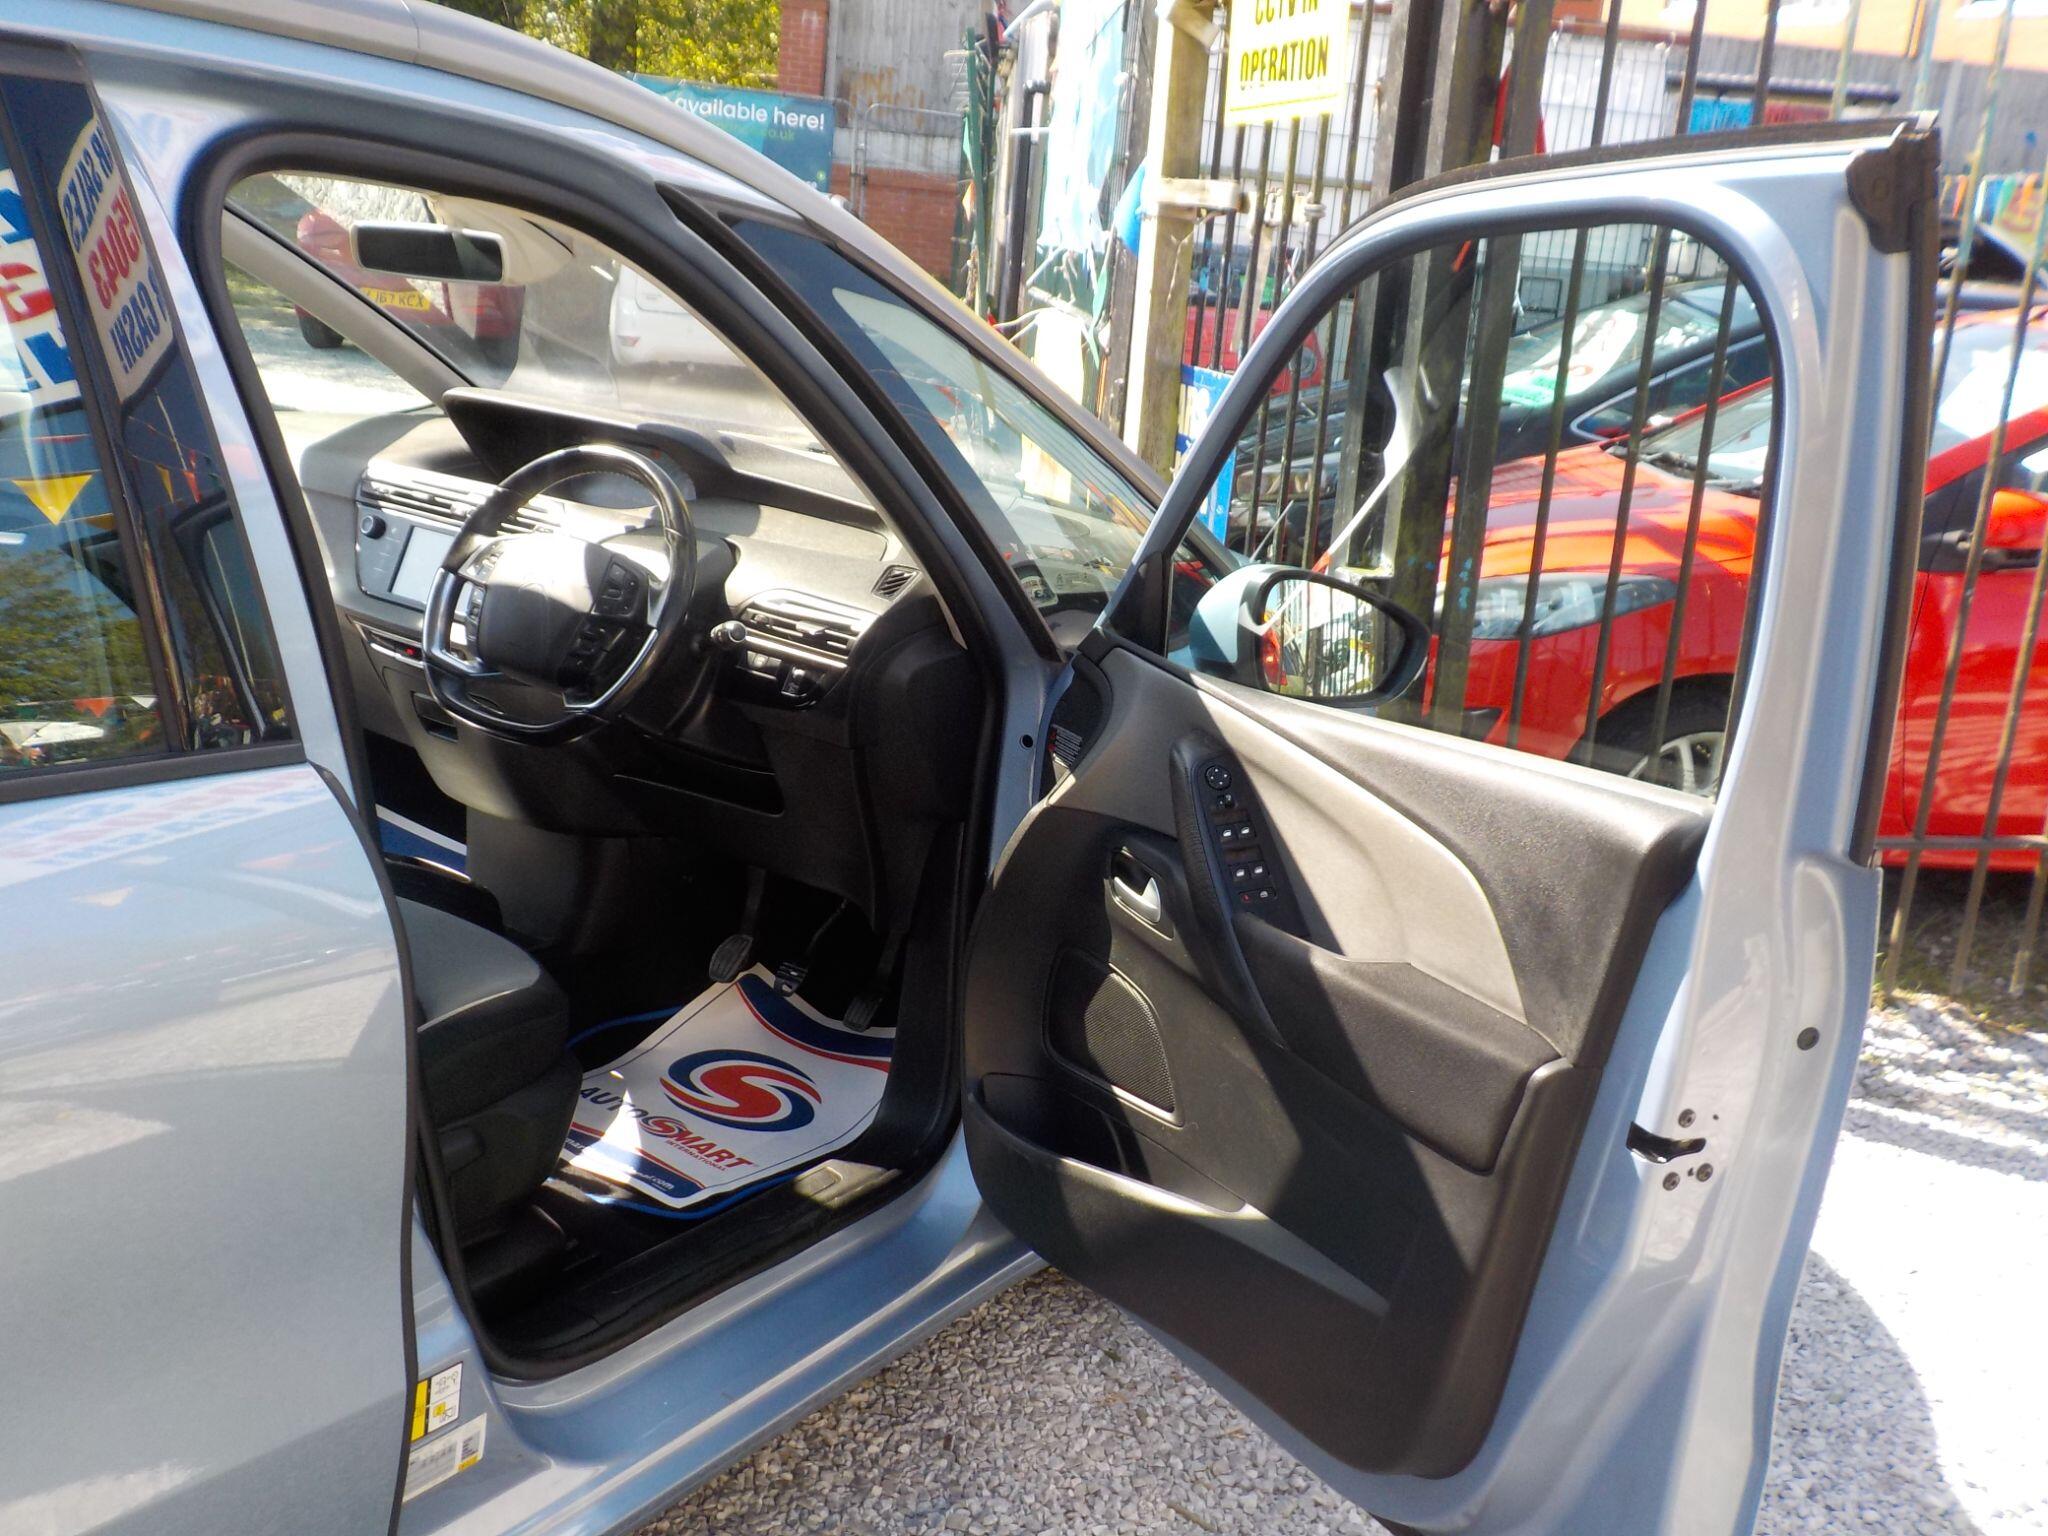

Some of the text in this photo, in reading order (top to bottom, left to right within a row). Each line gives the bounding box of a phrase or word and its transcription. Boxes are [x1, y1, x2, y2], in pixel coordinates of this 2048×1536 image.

[1240, 33, 1329, 91] OPERATION
[674, 96, 826, 131] available here!
[665, 1139, 727, 1172] INTERNATIONAL
